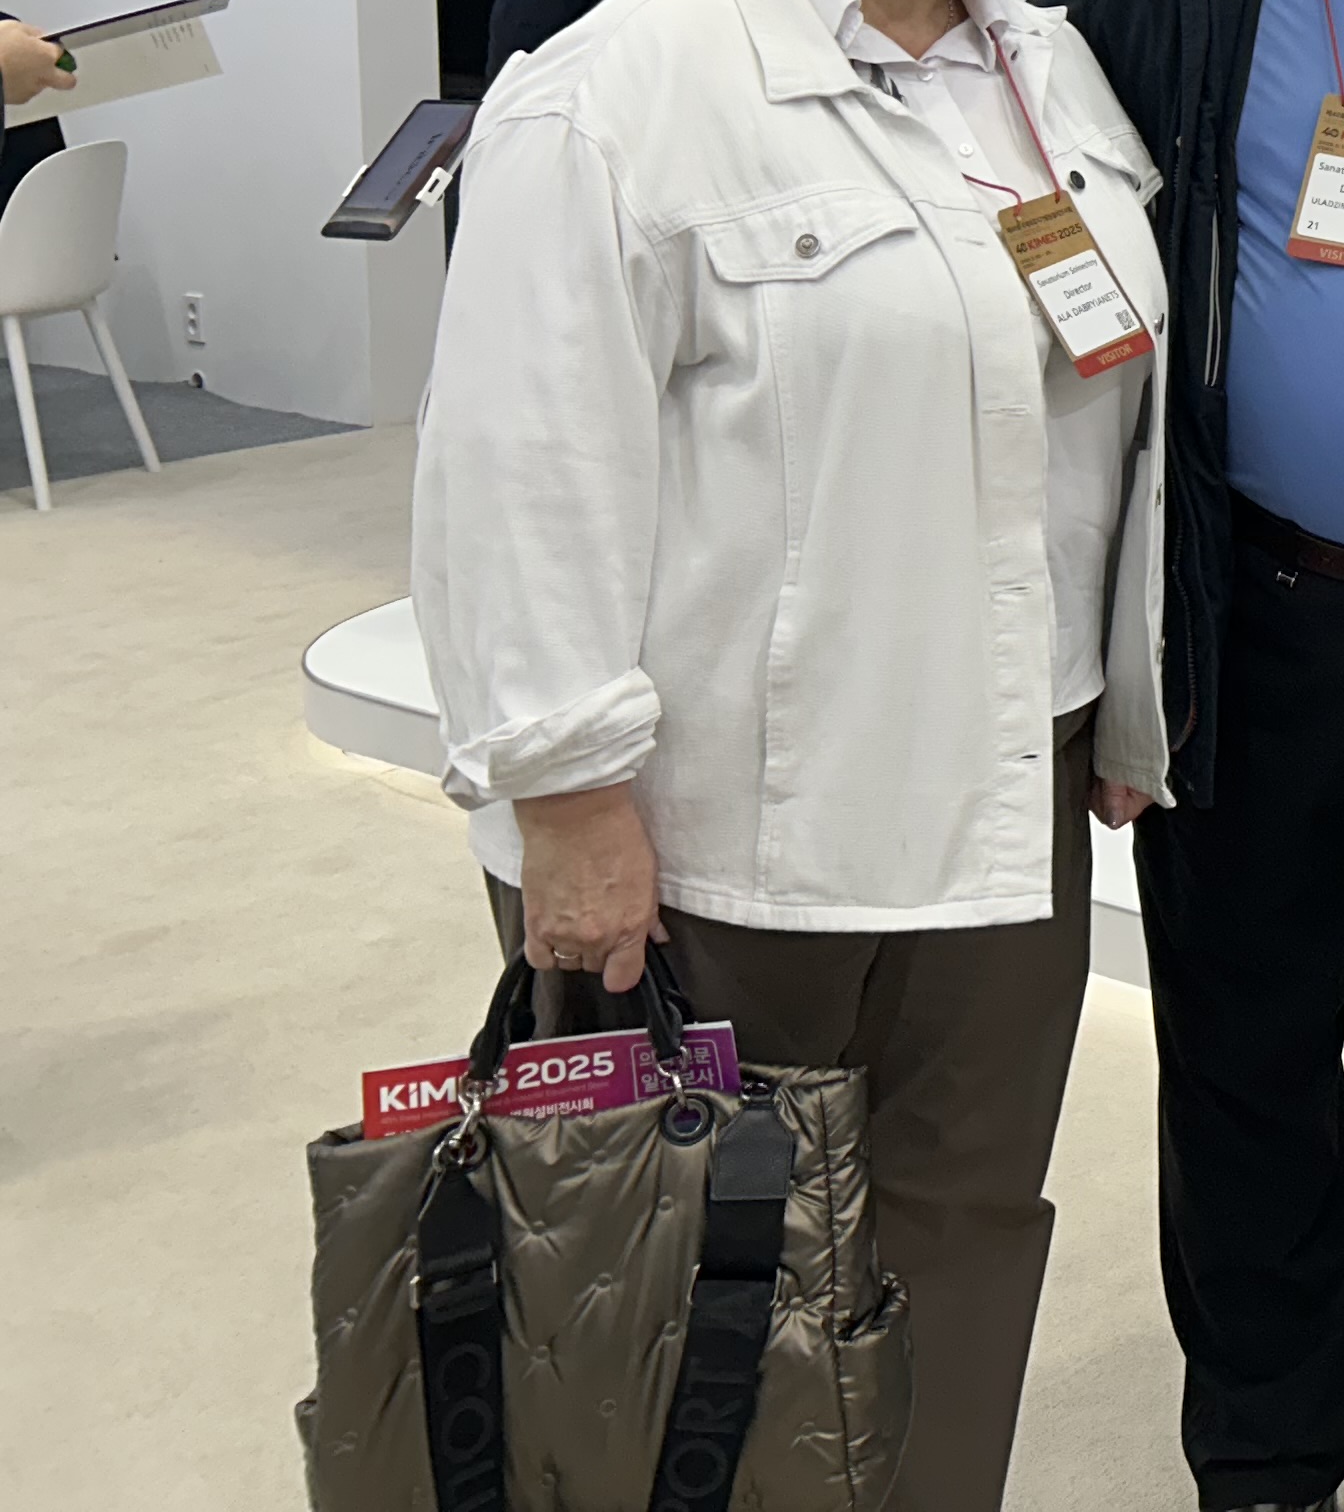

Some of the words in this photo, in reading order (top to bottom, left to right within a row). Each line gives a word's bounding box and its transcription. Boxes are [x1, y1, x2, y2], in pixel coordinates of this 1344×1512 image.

[1307, 220, 1319, 230] 21
[1027, 232, 1058, 251] KIMES
[1058, 223, 1083, 240] 2025
[1063, 281, 1093, 300] Director
[1098, 344, 1133, 366] VISITOR
[640, 1047, 711, 1068] 의문
[380, 1068, 510, 1113] KIMS
[516, 1051, 615, 1090] 2025
